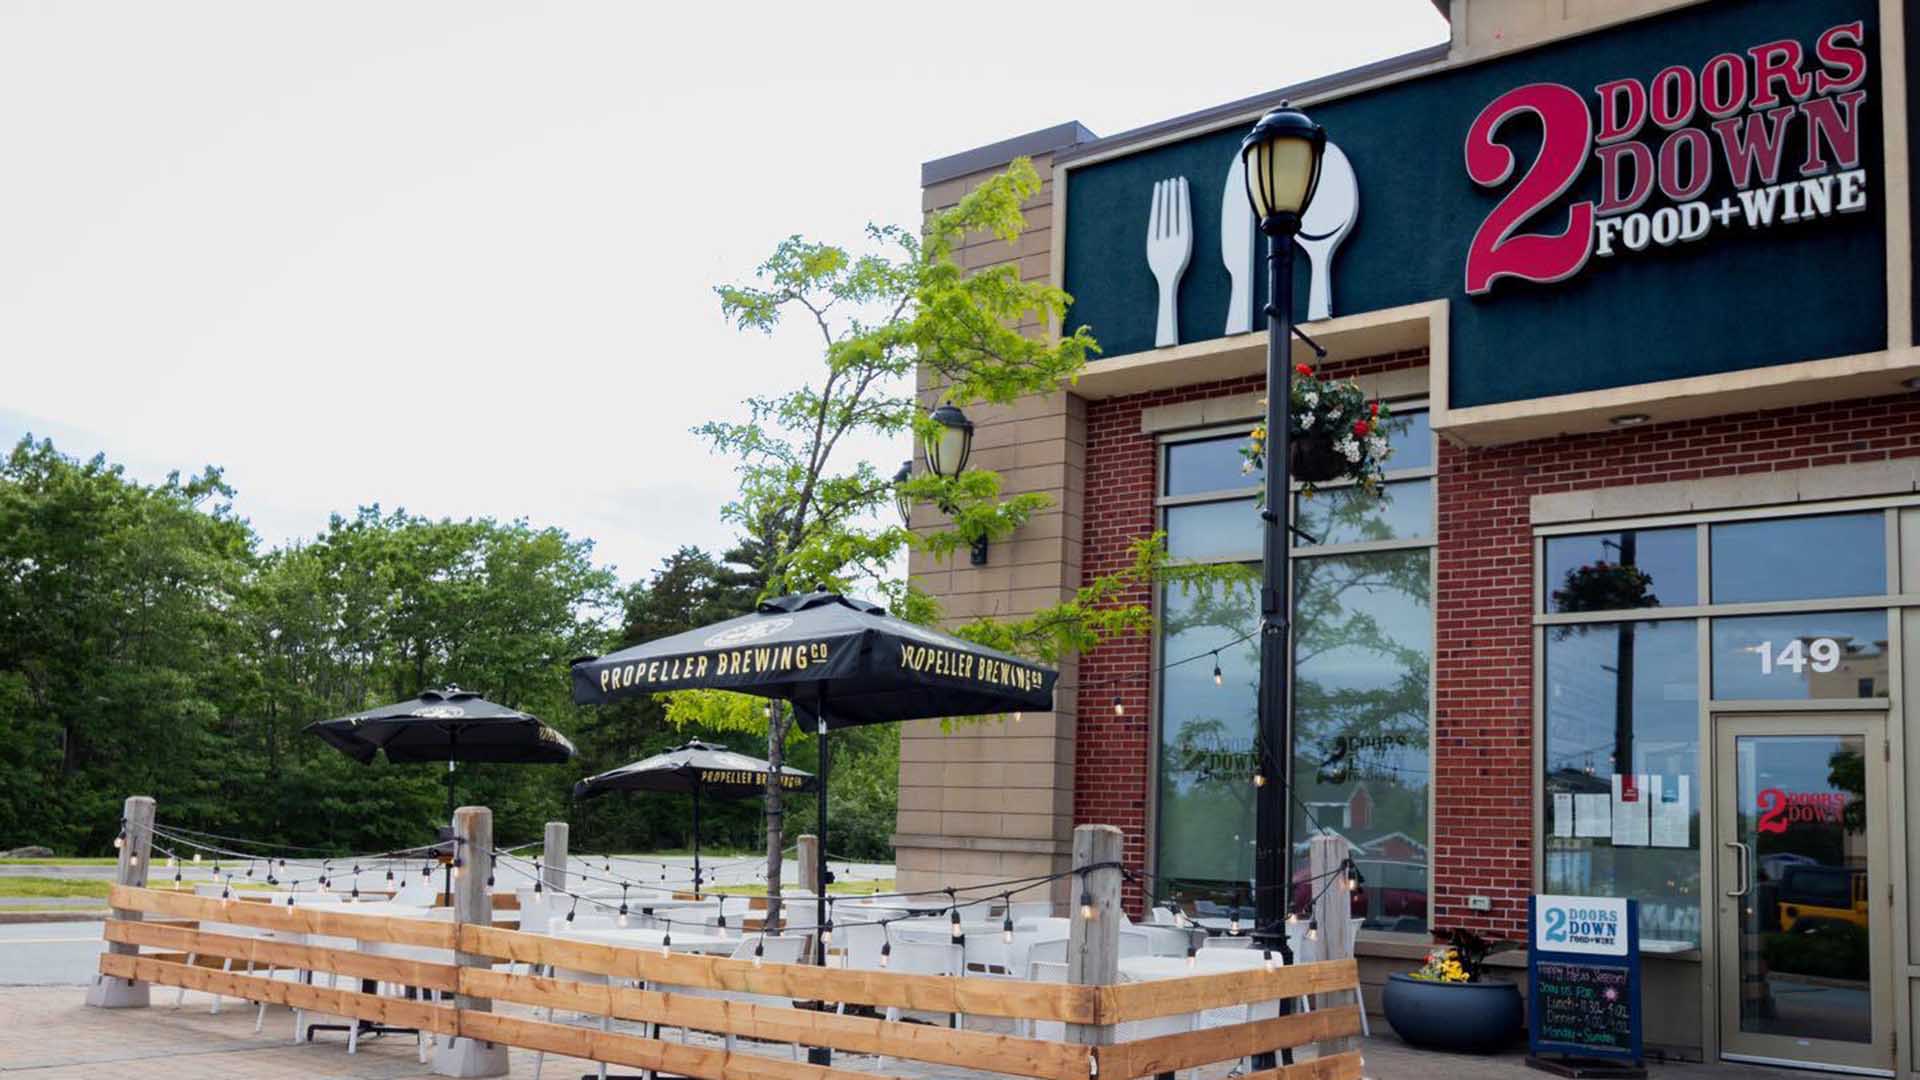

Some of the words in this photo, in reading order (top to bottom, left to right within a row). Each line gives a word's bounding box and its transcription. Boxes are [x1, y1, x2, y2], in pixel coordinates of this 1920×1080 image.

[1465, 82, 1593, 295] 2
[1595, 20, 1867, 142] DOORS
[1595, 91, 1866, 215] DOWN
[1596, 169, 1867, 256] FOOD+WINE
[601, 655, 708, 692] PROPELLER
[1756, 638, 1840, 675] 149
[702, 770, 752, 785] PROPELLER
[1757, 788, 1789, 833] 2
[1788, 805, 1845, 824] DOWN
[1544, 907, 1568, 943] 2
[1569, 908, 1618, 923] DOORS
[1569, 921, 1617, 937] DOWN
